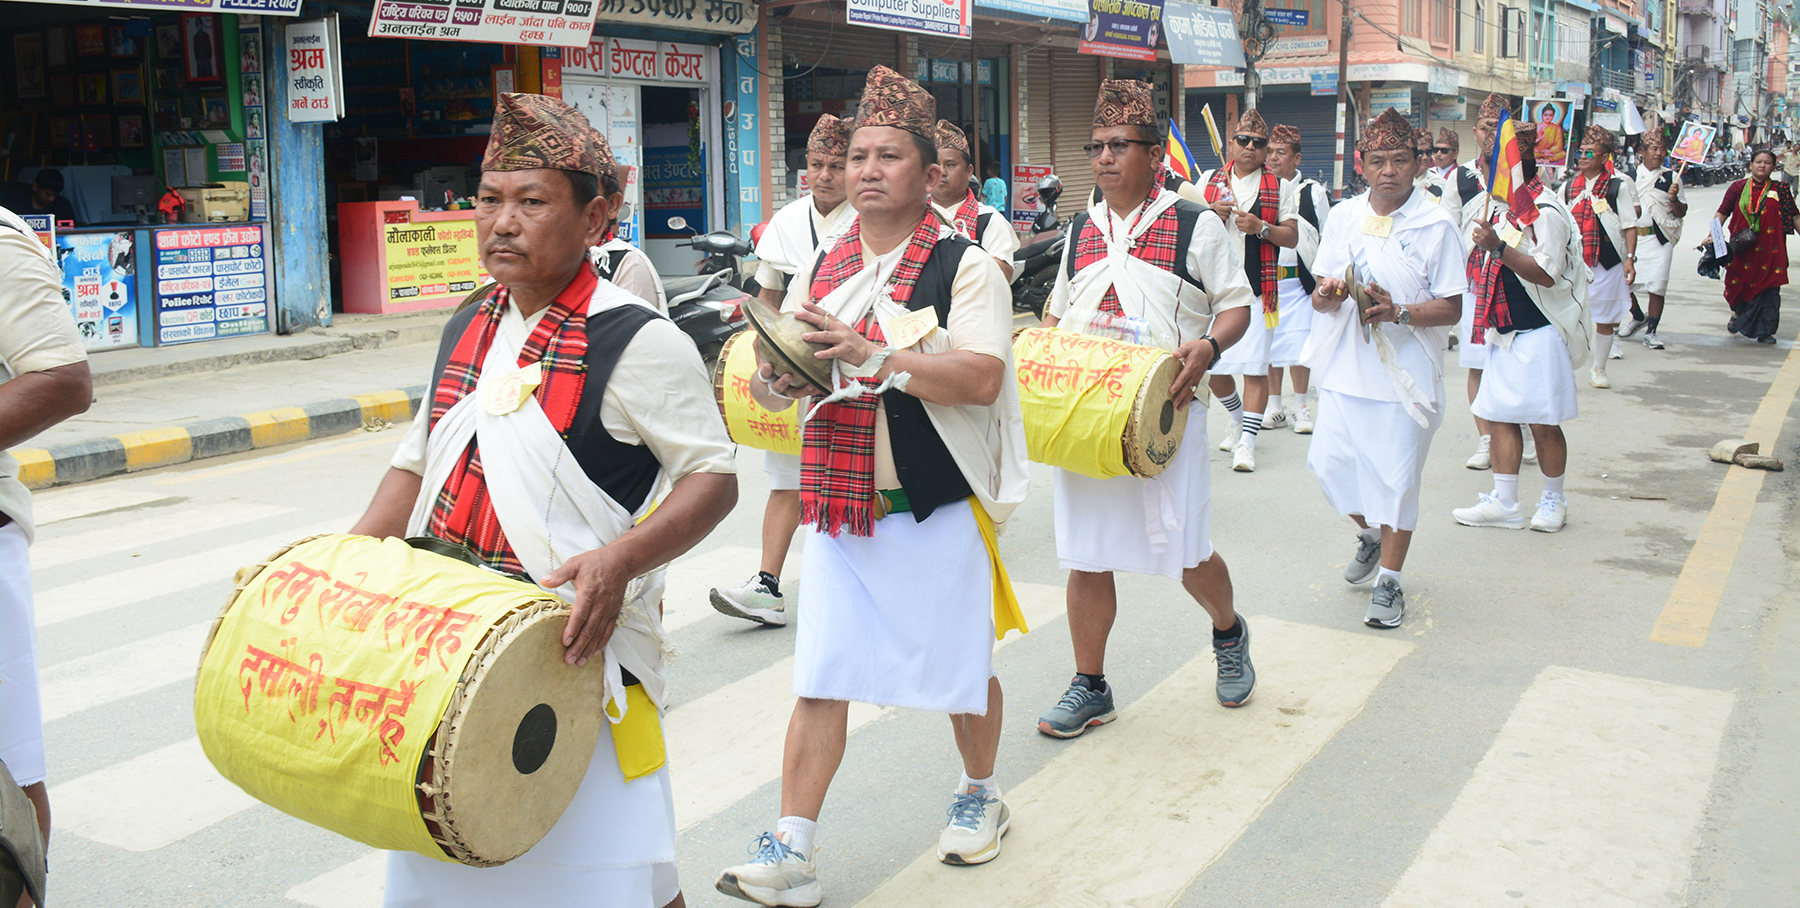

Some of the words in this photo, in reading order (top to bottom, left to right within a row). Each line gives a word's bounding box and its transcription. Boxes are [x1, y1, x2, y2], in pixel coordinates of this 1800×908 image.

[381, 4, 408, 20] राष्ट्रिय
[409, 6, 434, 19] परिचय
[435, 10, 449, 21] पत्र
[705, 0, 744, 25] सवा
[911, 0, 961, 20] Suppliers
[379, 23, 437, 36] अनलाईन
[440, 26, 461, 37] श्रम
[485, 14, 517, 26] लाईन
[547, 17, 567, 29] पनि
[568, 21, 592, 31] काम
[1191, 12, 1218, 38] मेडिको
[1291, 40, 1327, 49] CONSULTANCY
[290, 48, 325, 71] श्रम
[611, 39, 656, 78] डेण्टल
[665, 44, 703, 80] केयर
[933, 58, 958, 80] डेन्टल
[294, 75, 324, 92] स्वीकृति
[292, 96, 308, 109] गर्ने
[729, 126, 738, 174] pepsi
[181, 230, 202, 246] फोटो
[204, 232, 221, 245] एण्ड
[223, 229, 238, 246] फ्रेम
[386, 226, 436, 244] मौलाकाली
[437, 229, 452, 241] फोटो
[193, 265, 211, 275] फारम
[216, 259, 241, 272] पासपोर्ट
[243, 258, 262, 270] फोटो
[77, 284, 100, 297] श्रम
[219, 277, 239, 288] ईमेल
[240, 277, 263, 286] Gmil
[161, 297, 192, 308] Police
[236, 289, 264, 301] फोटोकपी
[161, 315, 185, 325] Vaccine
[186, 311, 199, 323] QR
[219, 307, 239, 319] छाप
[219, 319, 265, 329] Online
[162, 326, 192, 340] संस्थाको
[1027, 329, 1058, 355] तमु
[1060, 333, 1099, 351] सेवा
[262, 561, 331, 626] तमु
[318, 571, 399, 632] सेवा
